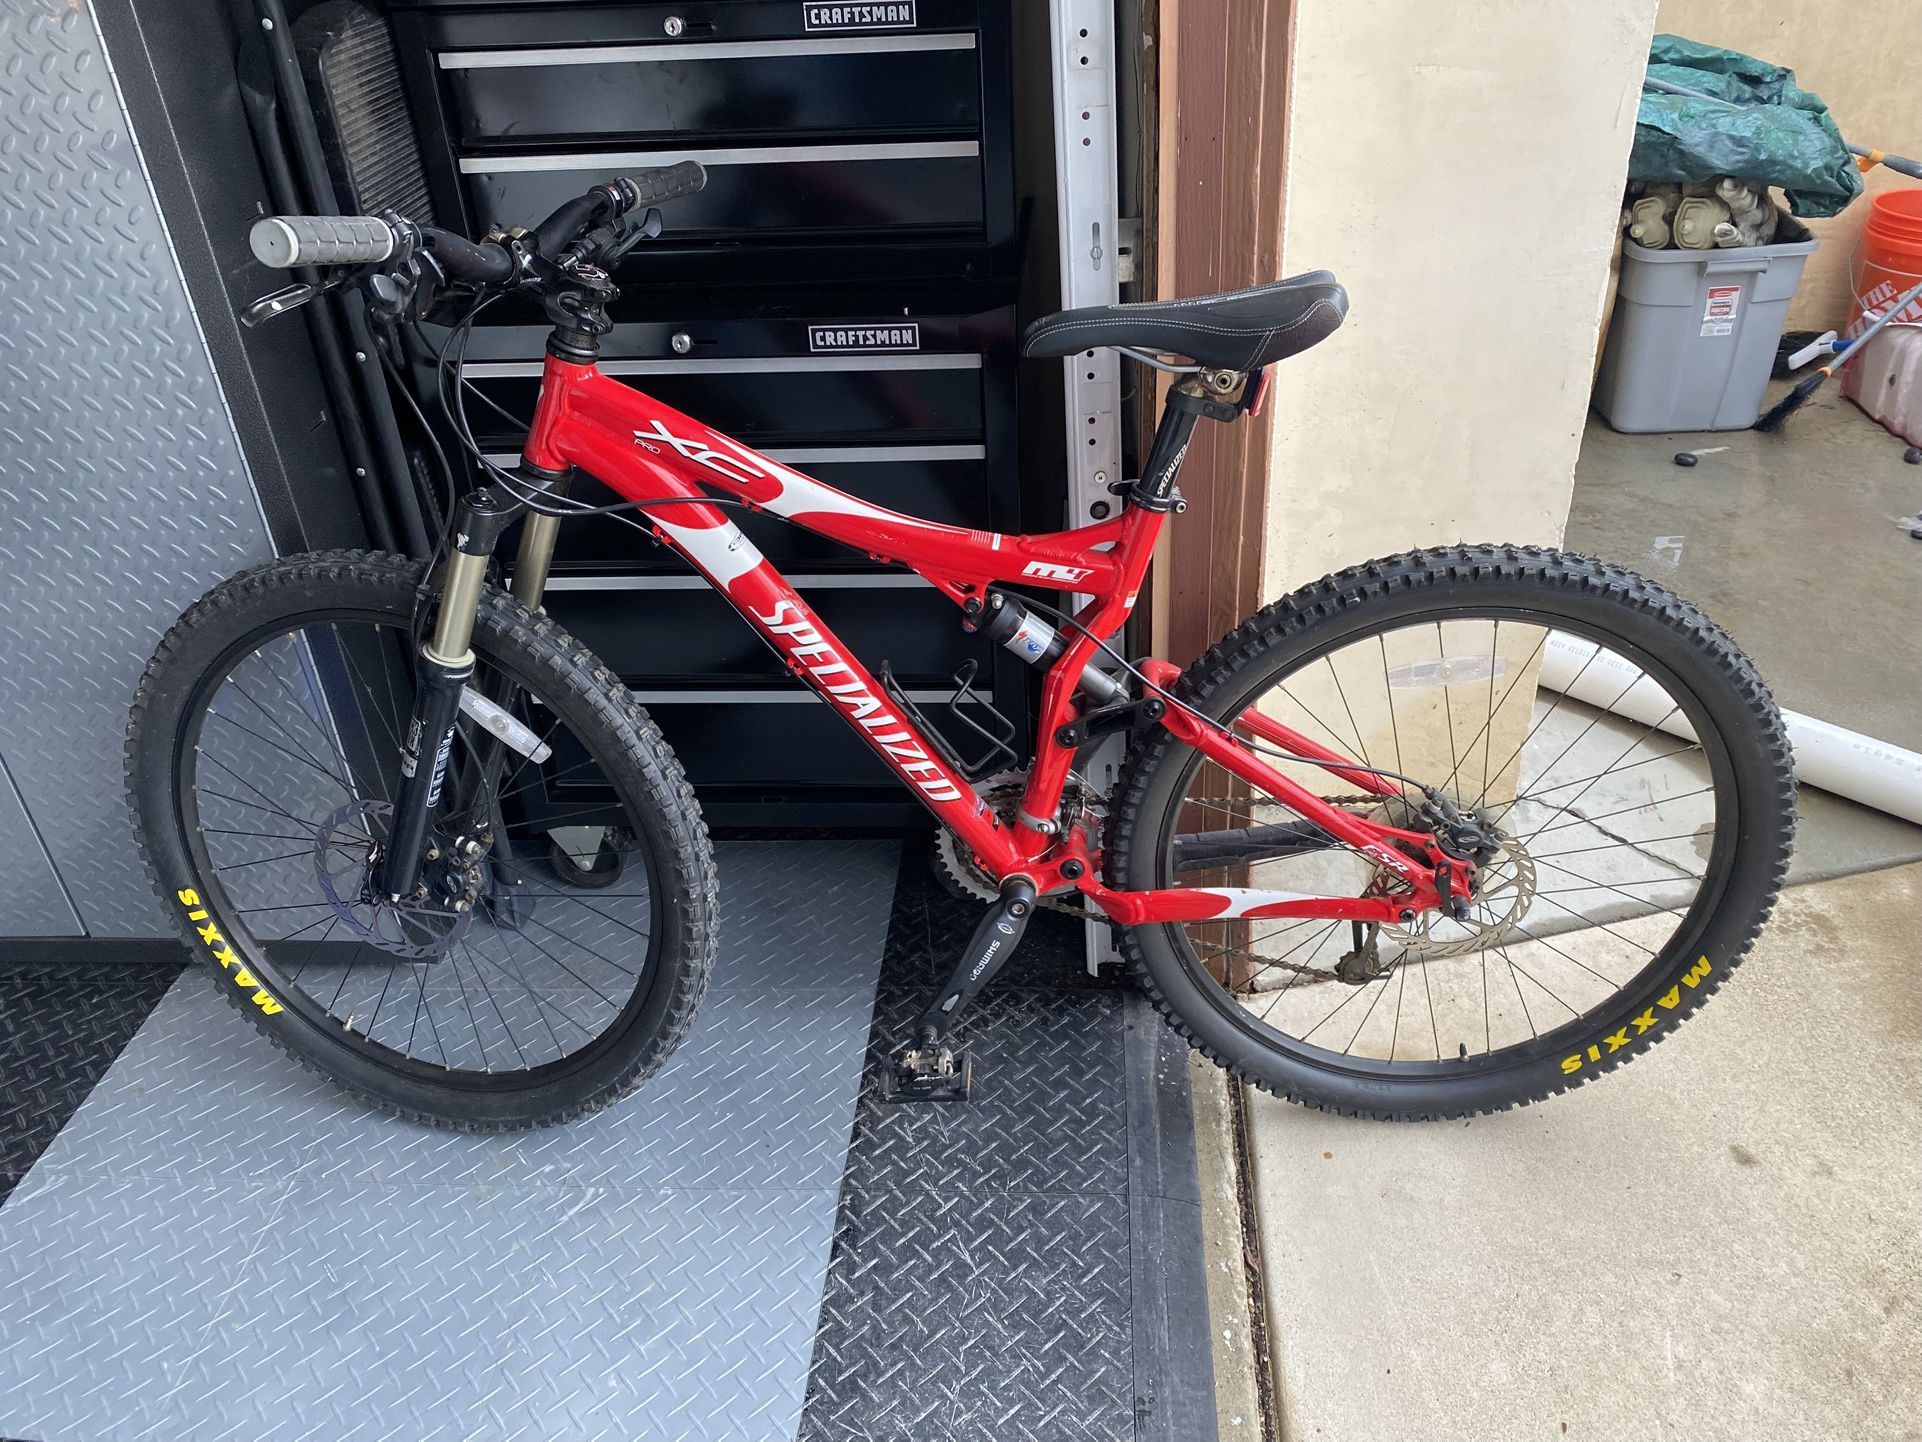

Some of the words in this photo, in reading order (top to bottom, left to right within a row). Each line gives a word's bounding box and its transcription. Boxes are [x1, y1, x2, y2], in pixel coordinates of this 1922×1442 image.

[810, 5, 910, 24] CRAFTSMAN
[1861, 280, 1897, 309] THE
[815, 329, 912, 346] CRAFTSMAN
[633, 420, 766, 483] XC
[634, 438, 661, 455] PRO
[748, 600, 962, 802] SPECIALIZED
[177, 888, 285, 1016] MAXXIS
[1560, 954, 1713, 1075] MAXXIS
